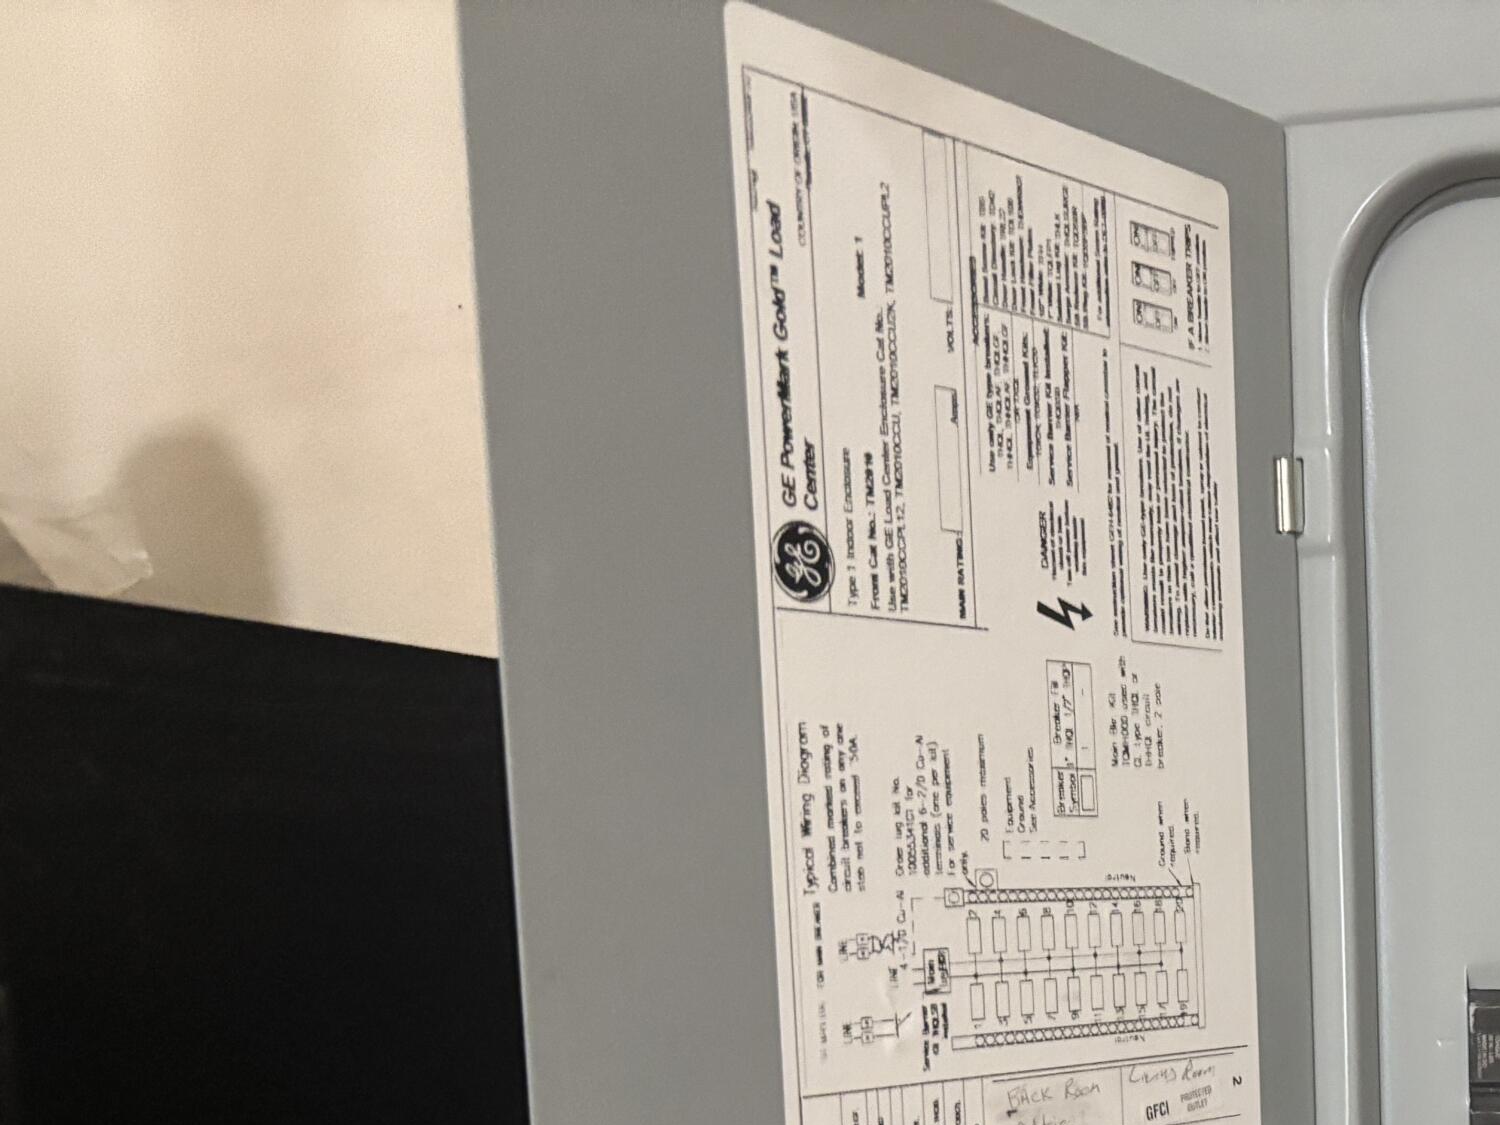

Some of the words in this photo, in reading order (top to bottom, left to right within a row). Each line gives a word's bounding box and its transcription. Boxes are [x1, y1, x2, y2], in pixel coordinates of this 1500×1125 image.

[765, 198, 783, 259] Load
[795, 186, 806, 246] COUNTRY
[1185, 261, 1194, 323] BREAKER
[875, 336, 885, 362] Cat
[877, 365, 888, 435] Enclosure
[984, 371, 994, 399] type
[774, 347, 794, 470] PowerMark
[986, 401, 994, 419] GE
[987, 422, 996, 447] only
[800, 436, 818, 511] Center
[840, 446, 852, 513] Enclosure
[880, 441, 891, 485] Center
[988, 450, 996, 472] Use
[1047, 442, 1055, 485] Service
[1064, 444, 1073, 486] Service
[781, 474, 796, 507] GE
[883, 488, 893, 523] Load
[844, 518, 855, 558] Indoor
[885, 526, 894, 549] GE
[1038, 510, 1048, 568] DANGER
[886, 552, 896, 582] with
[847, 575, 858, 606] Type
[869, 573, 880, 609] Front
[888, 586, 897, 611] Use
[958, 589, 966, 618] MAIN
[794, 720, 813, 784] Diagram
[1026, 746, 1036, 809] Accessories
[798, 792, 816, 837] Wiring
[838, 799, 849, 849] breakers
[1016, 794, 1025, 833] Ground
[825, 836, 837, 892] Combined
[919, 821, 930, 875] additional
[801, 847, 819, 895] Typical
[841, 857, 851, 891] circuit
[1181, 1058, 1216, 1081] Room
[1233, 1076, 1243, 1086] 2
[1064, 1078, 1100, 1100] Room
[1180, 1085, 1213, 1103] PROTECTED
[1187, 1098, 1208, 1113] OUTLET
[1146, 1101, 1170, 1122] GFCI
